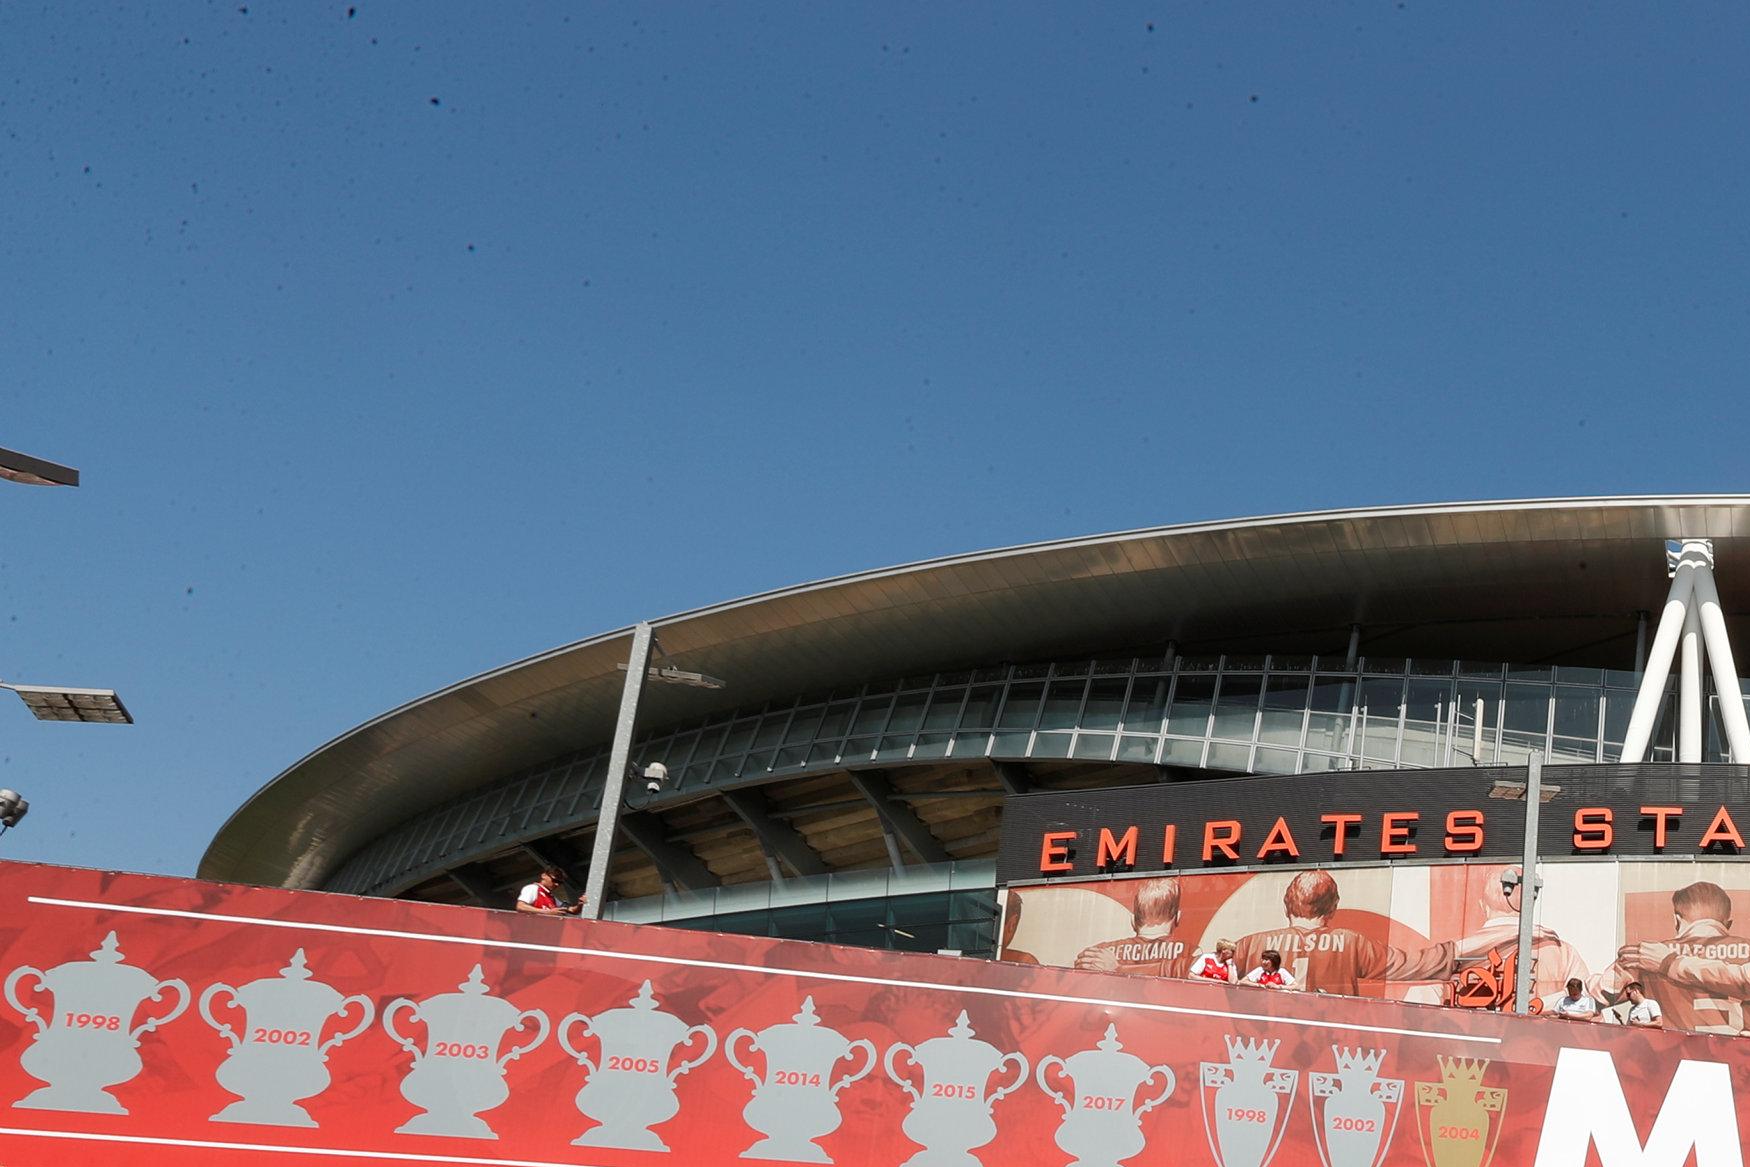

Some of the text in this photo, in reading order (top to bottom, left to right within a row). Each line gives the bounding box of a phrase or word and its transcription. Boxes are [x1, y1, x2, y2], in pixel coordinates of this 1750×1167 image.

[1040, 809, 1484, 873] EMIRATES
[1266, 933, 1344, 953] WILSON
[64, 1011, 120, 1032] 1998
[253, 1027, 312, 1046] 2002
[434, 1041, 489, 1060] 2003
[608, 1055, 660, 1075] 2005
[774, 1069, 822, 1088] 2014
[931, 1082, 976, 1100] 2015
[1083, 1094, 1125, 1112] 2017
[1226, 1106, 1267, 1124] 1998
[1332, 1116, 1376, 1133] 2002
[1438, 1124, 1481, 1141] 2004
